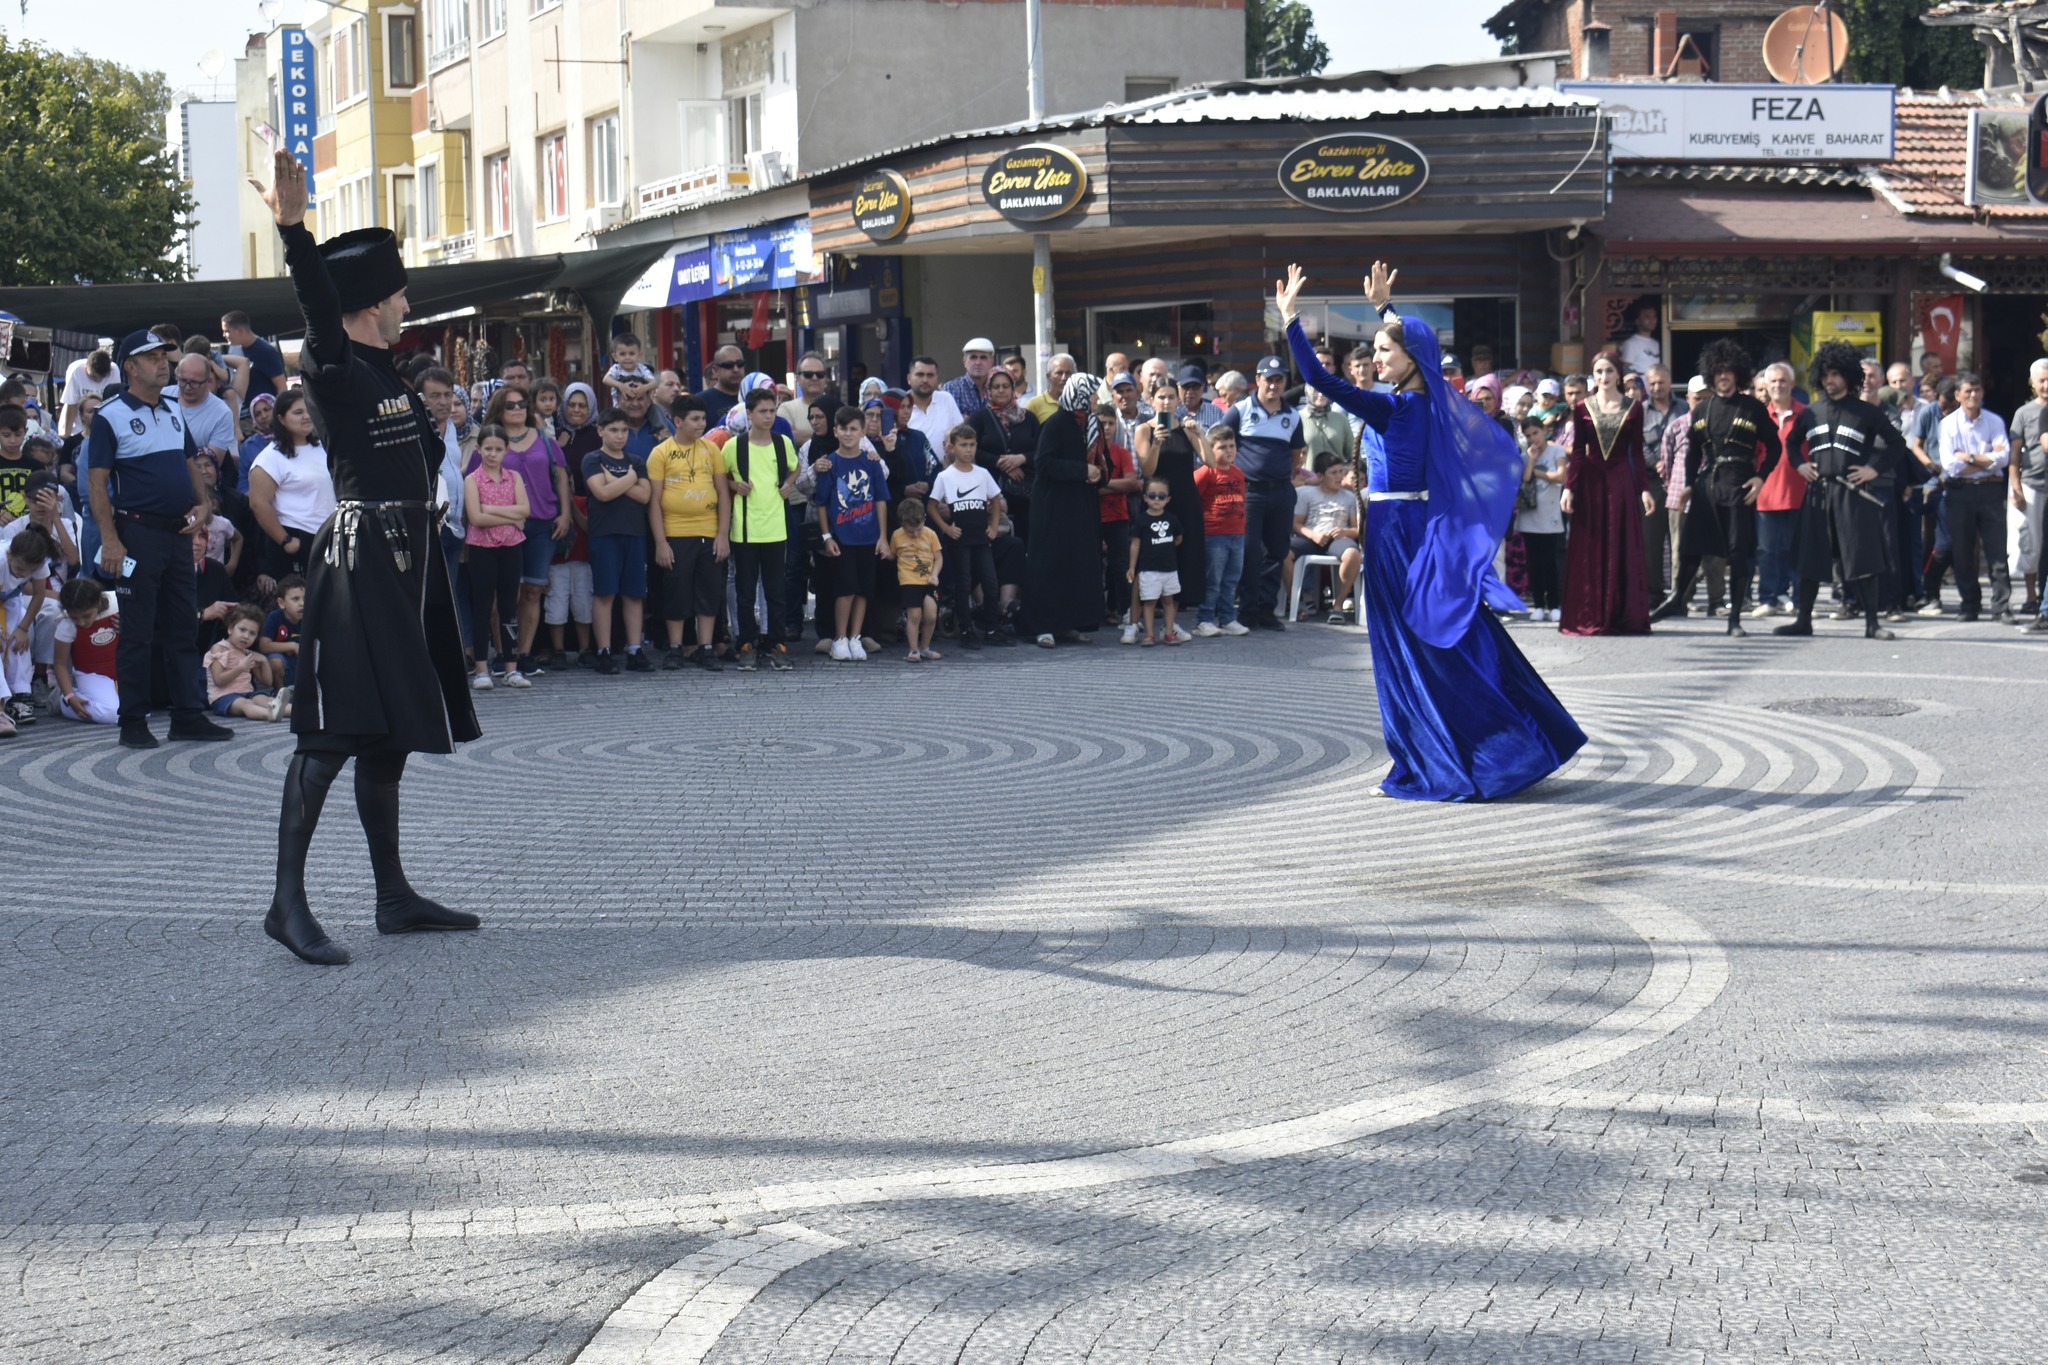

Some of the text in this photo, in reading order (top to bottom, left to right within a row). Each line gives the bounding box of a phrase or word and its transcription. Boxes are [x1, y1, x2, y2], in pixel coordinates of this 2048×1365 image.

[290, 32, 308, 115] DEKOR
[1752, 97, 1825, 121] FEZA
[1612, 109, 1666, 134] BAH
[1689, 132, 1885, 147] KURUYEMİŞ KAHVE BAHARAT
[1290, 157, 1416, 182] Evren Usta
[988, 168, 1072, 195] Evren Usta
[1307, 185, 1400, 198] BAKLAVALARI
[855, 191, 898, 216] Evren Usta
[1000, 194, 1063, 209] BAKLAVALARI
[862, 214, 895, 229] BAKLAVALARI
[677, 268, 690, 286] UMUT
[668, 448, 691, 460] ABOUT
[953, 501, 969, 512] JUST
[970, 500, 979, 510] DO
